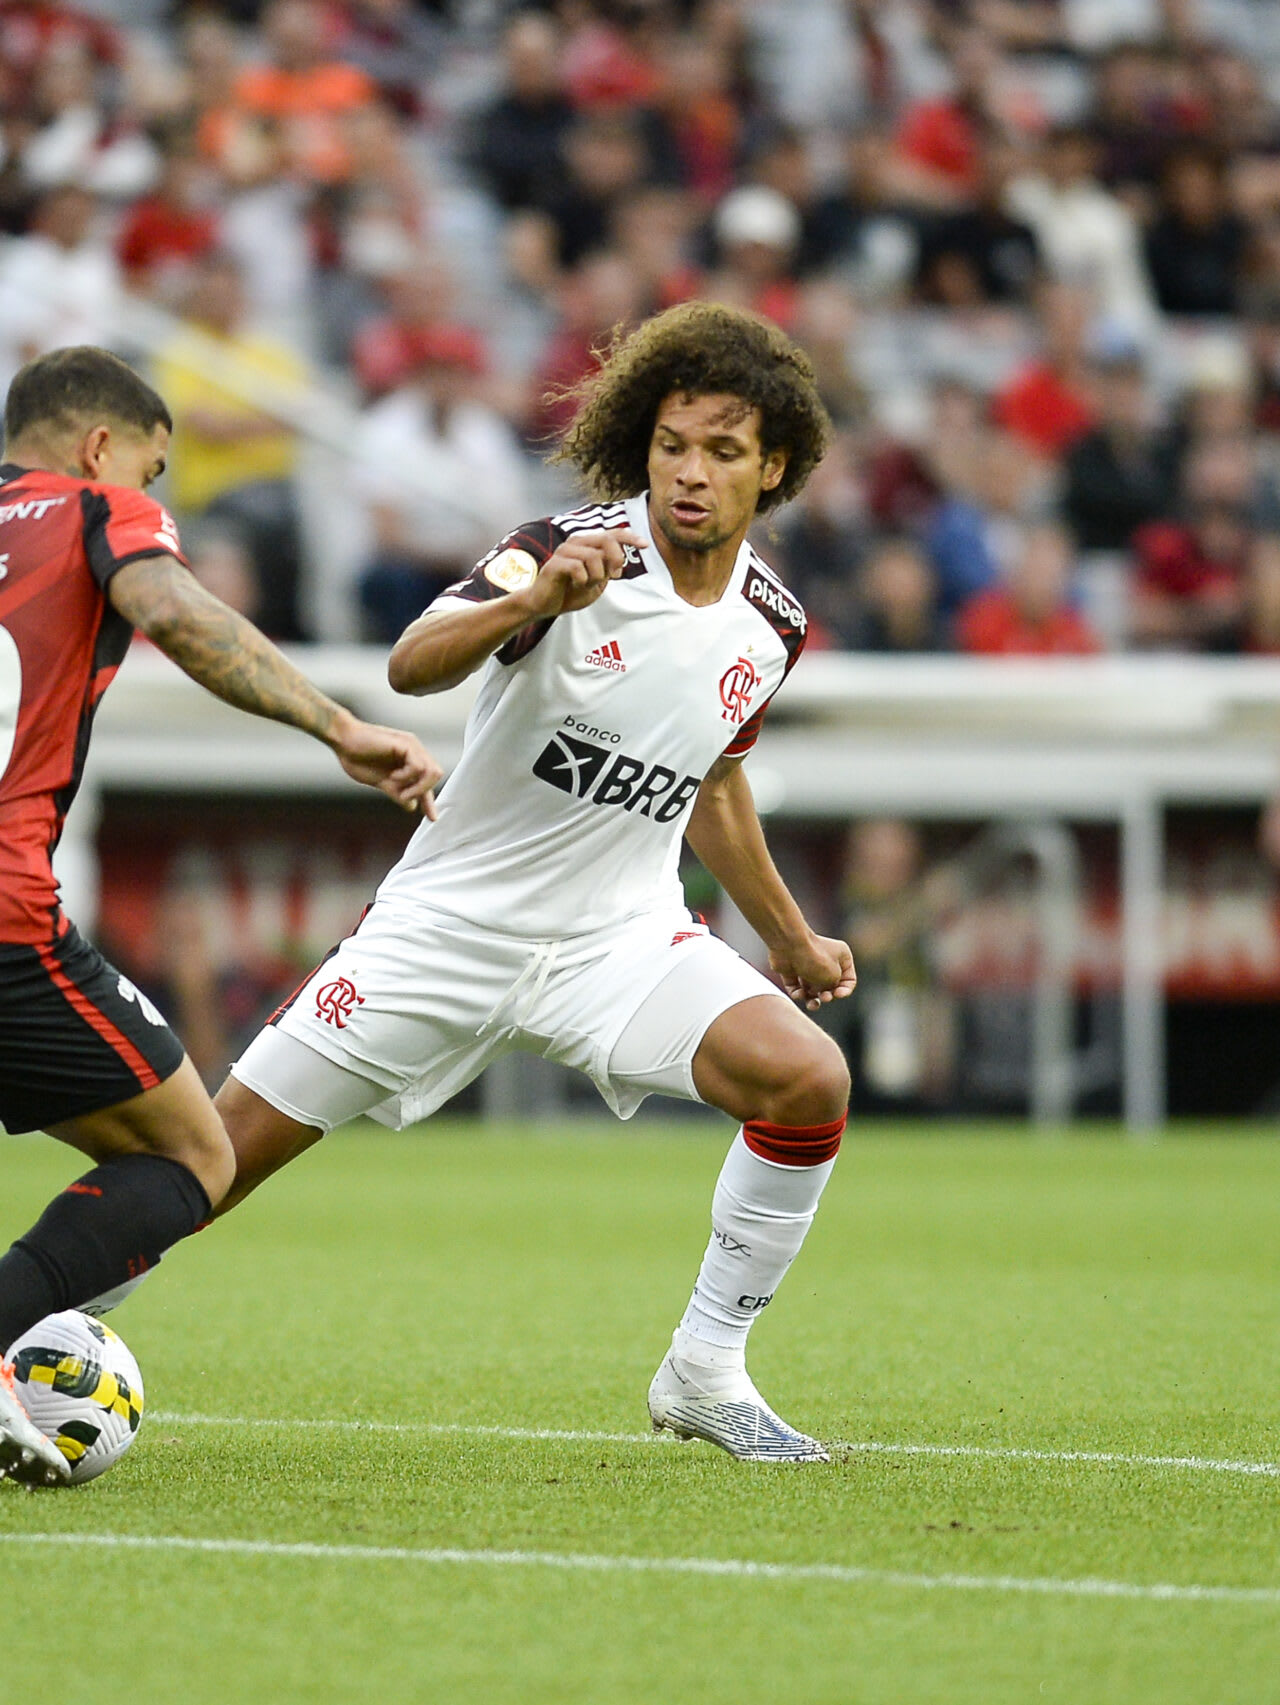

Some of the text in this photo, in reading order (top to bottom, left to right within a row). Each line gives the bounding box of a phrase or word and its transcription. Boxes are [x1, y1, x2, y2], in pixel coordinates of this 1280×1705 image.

[584, 653, 627, 673] adidas
[563, 714, 622, 745] banco
[592, 753, 702, 824] BRB
